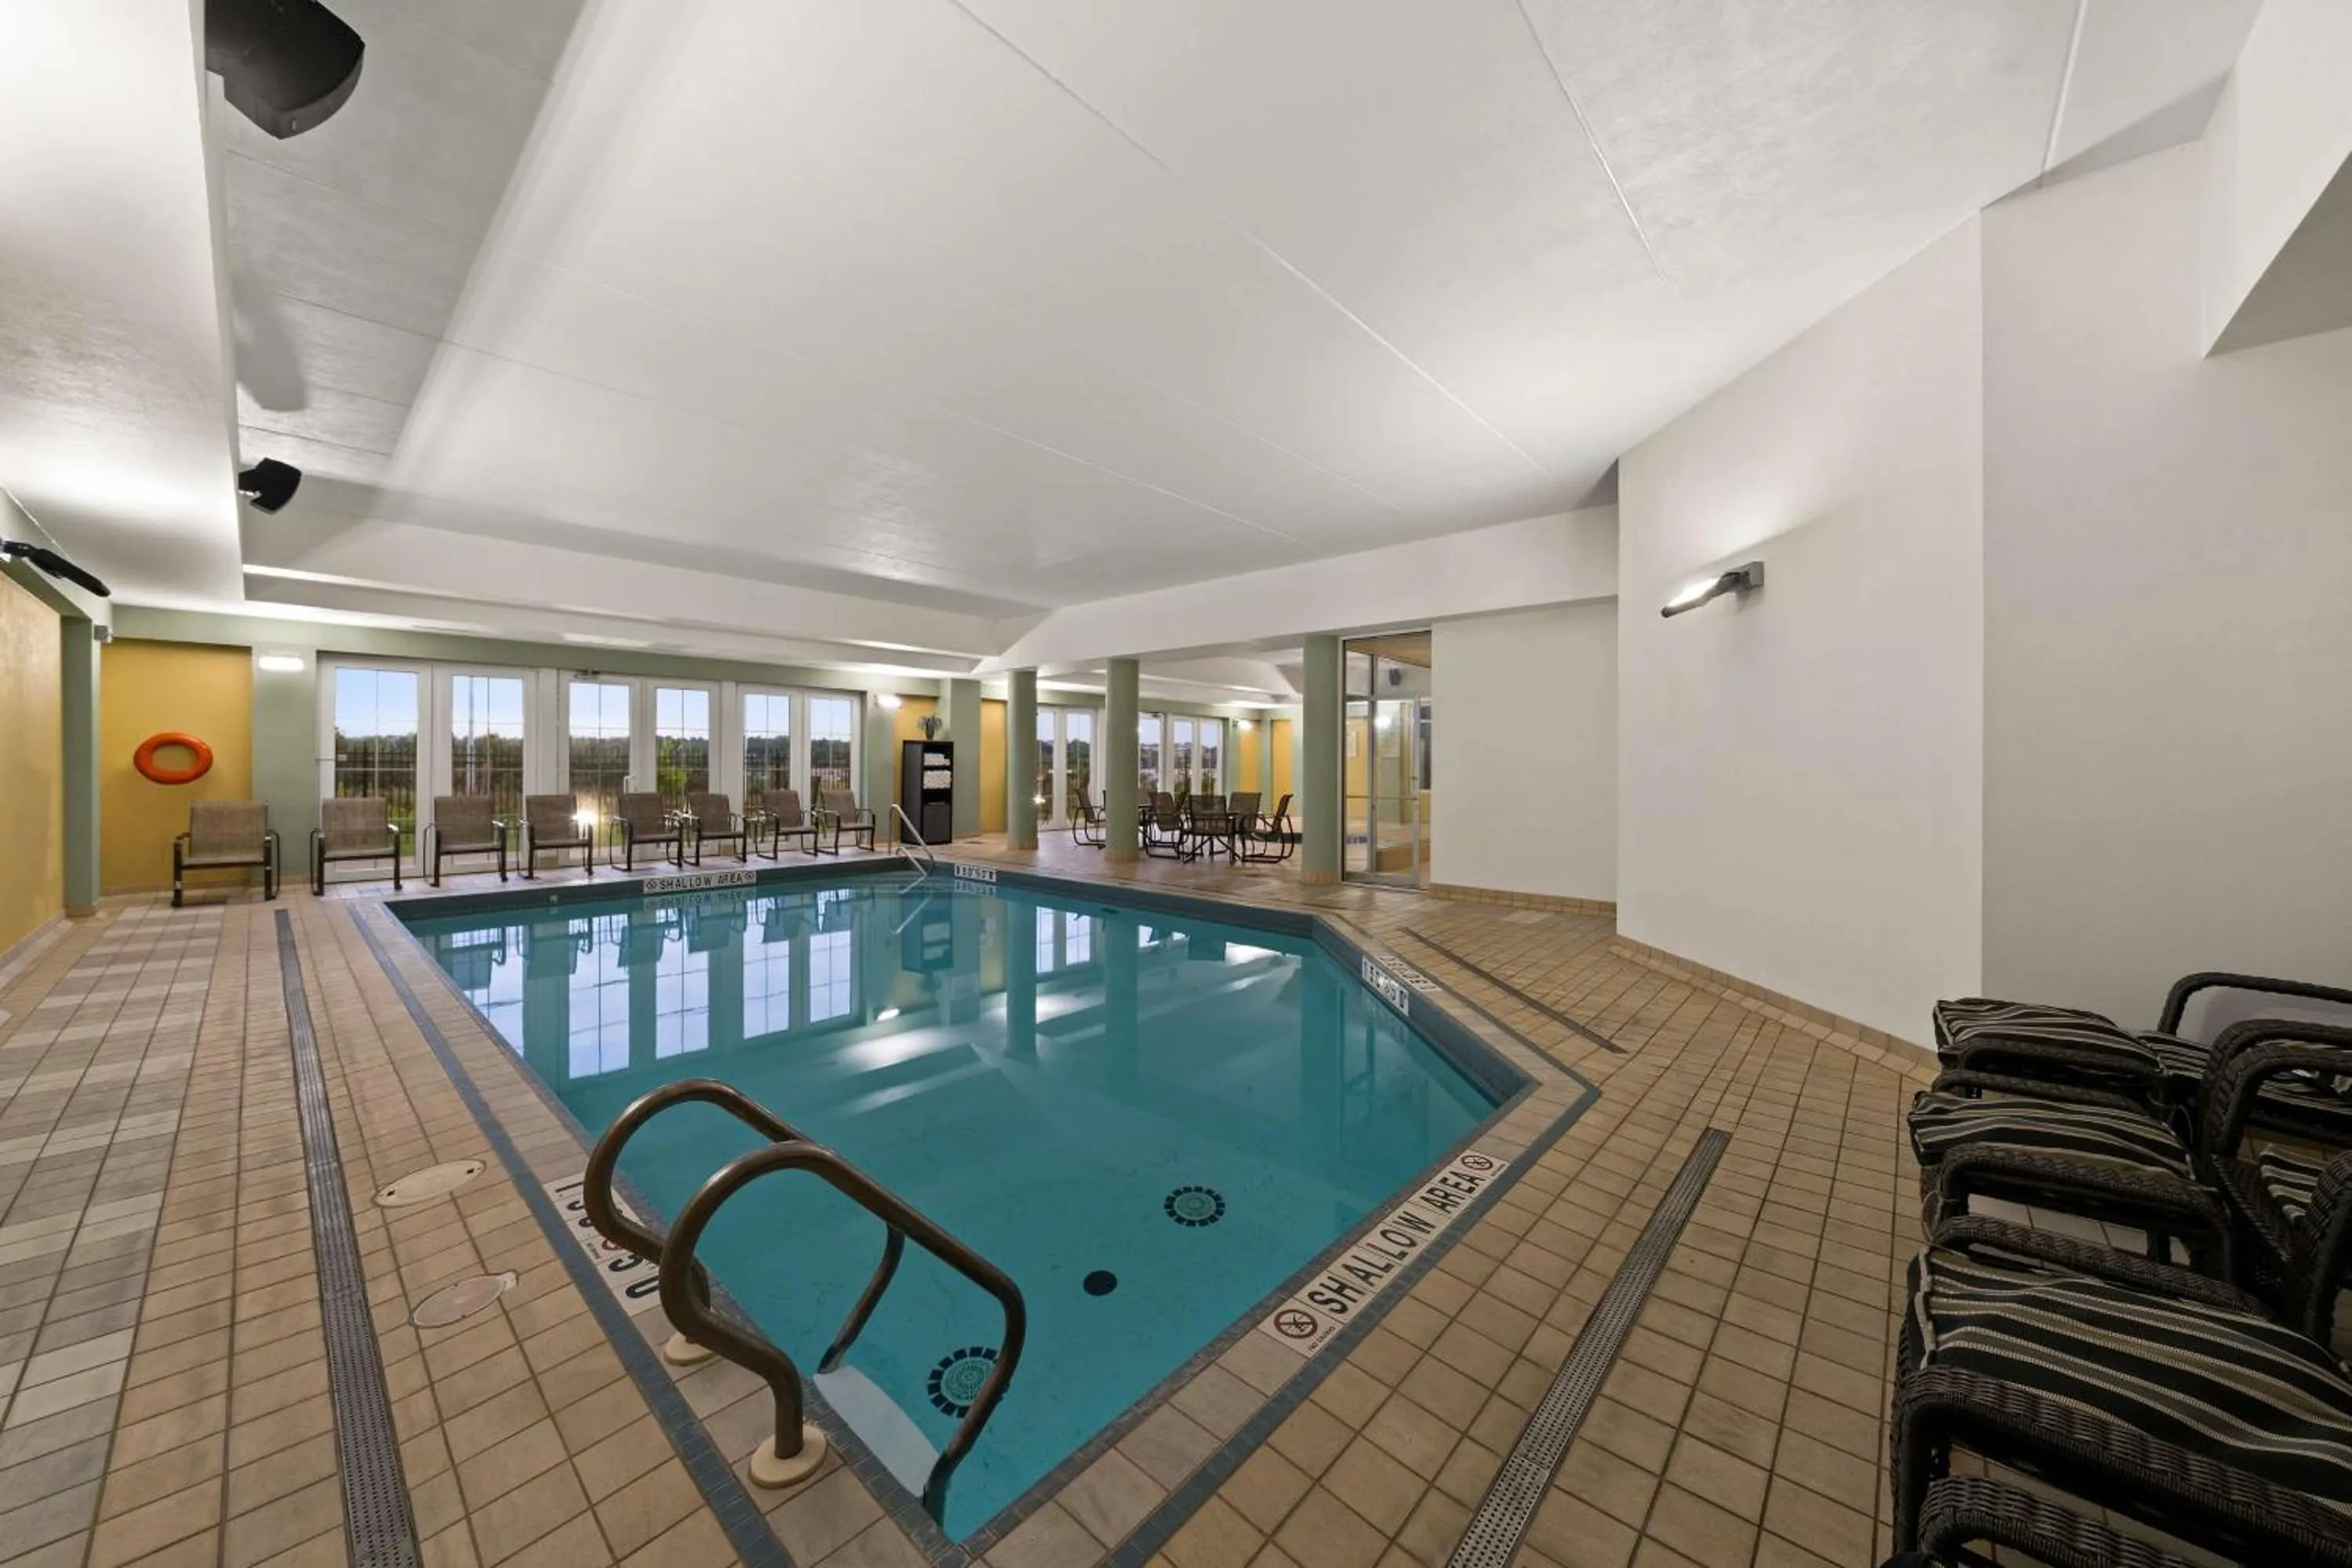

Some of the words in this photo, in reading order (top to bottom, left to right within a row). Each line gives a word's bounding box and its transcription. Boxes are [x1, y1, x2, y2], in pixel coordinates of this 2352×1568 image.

[659, 877, 713, 890] SHALLOW
[717, 874, 742, 884] AREA
[1308, 1210, 1436, 1315] SHALLOW
[1421, 1171, 1486, 1214] AREA
